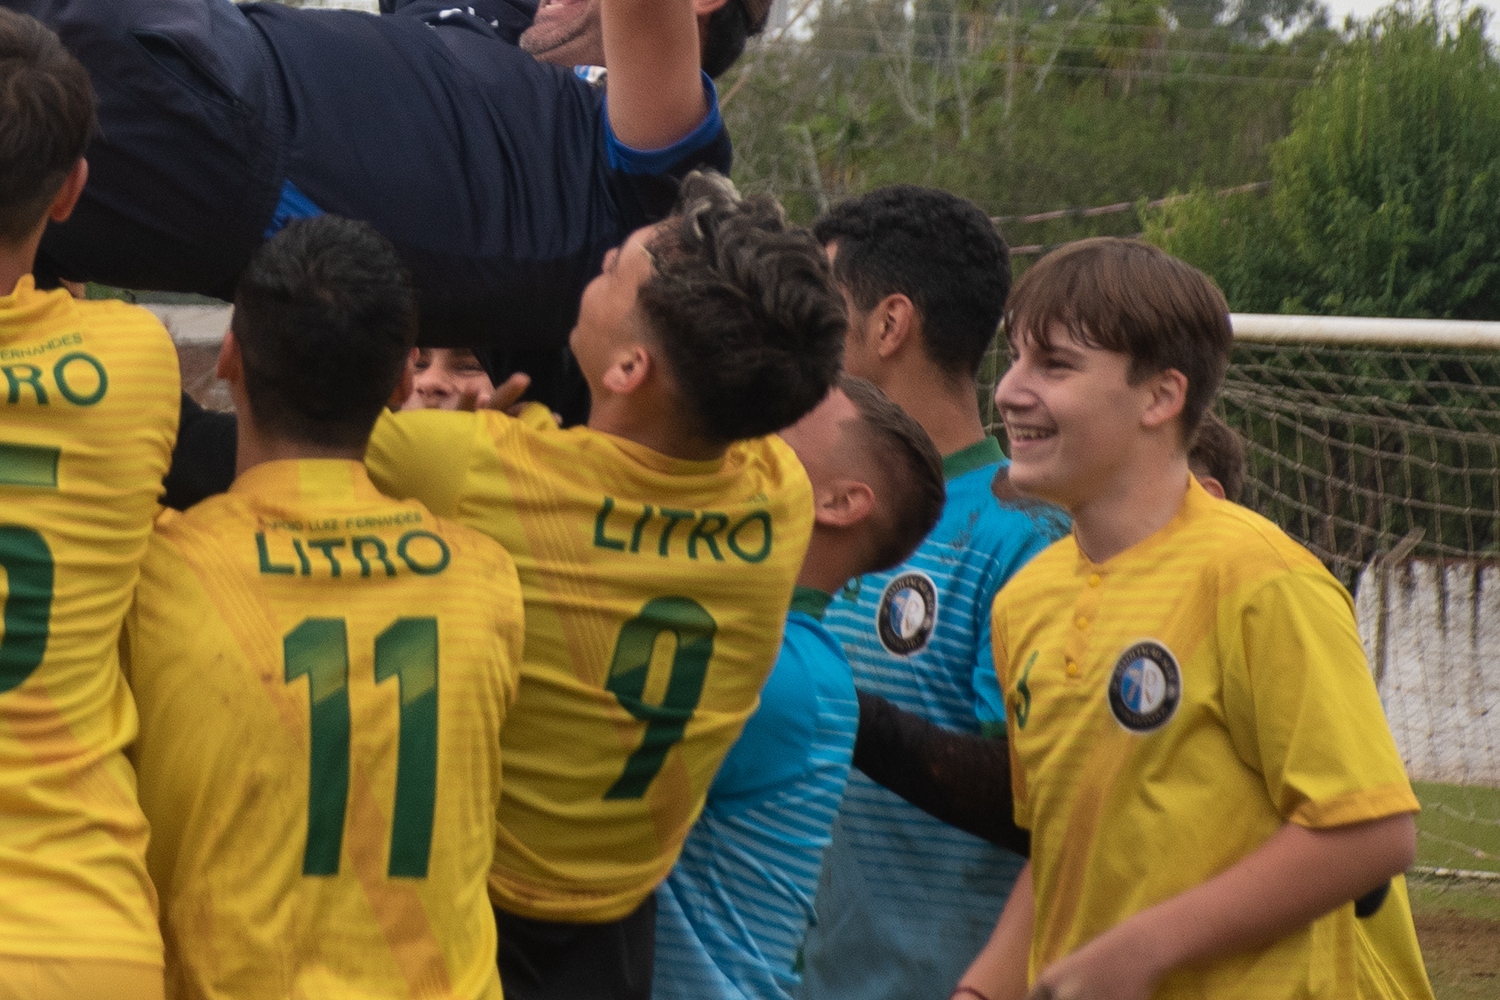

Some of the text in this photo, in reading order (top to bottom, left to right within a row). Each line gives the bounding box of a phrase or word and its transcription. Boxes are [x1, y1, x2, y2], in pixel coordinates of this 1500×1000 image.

[255, 530, 451, 577] LITRO
[594, 496, 773, 564] LITRO
[283, 616, 439, 879] 11
[604, 595, 718, 799] 9
